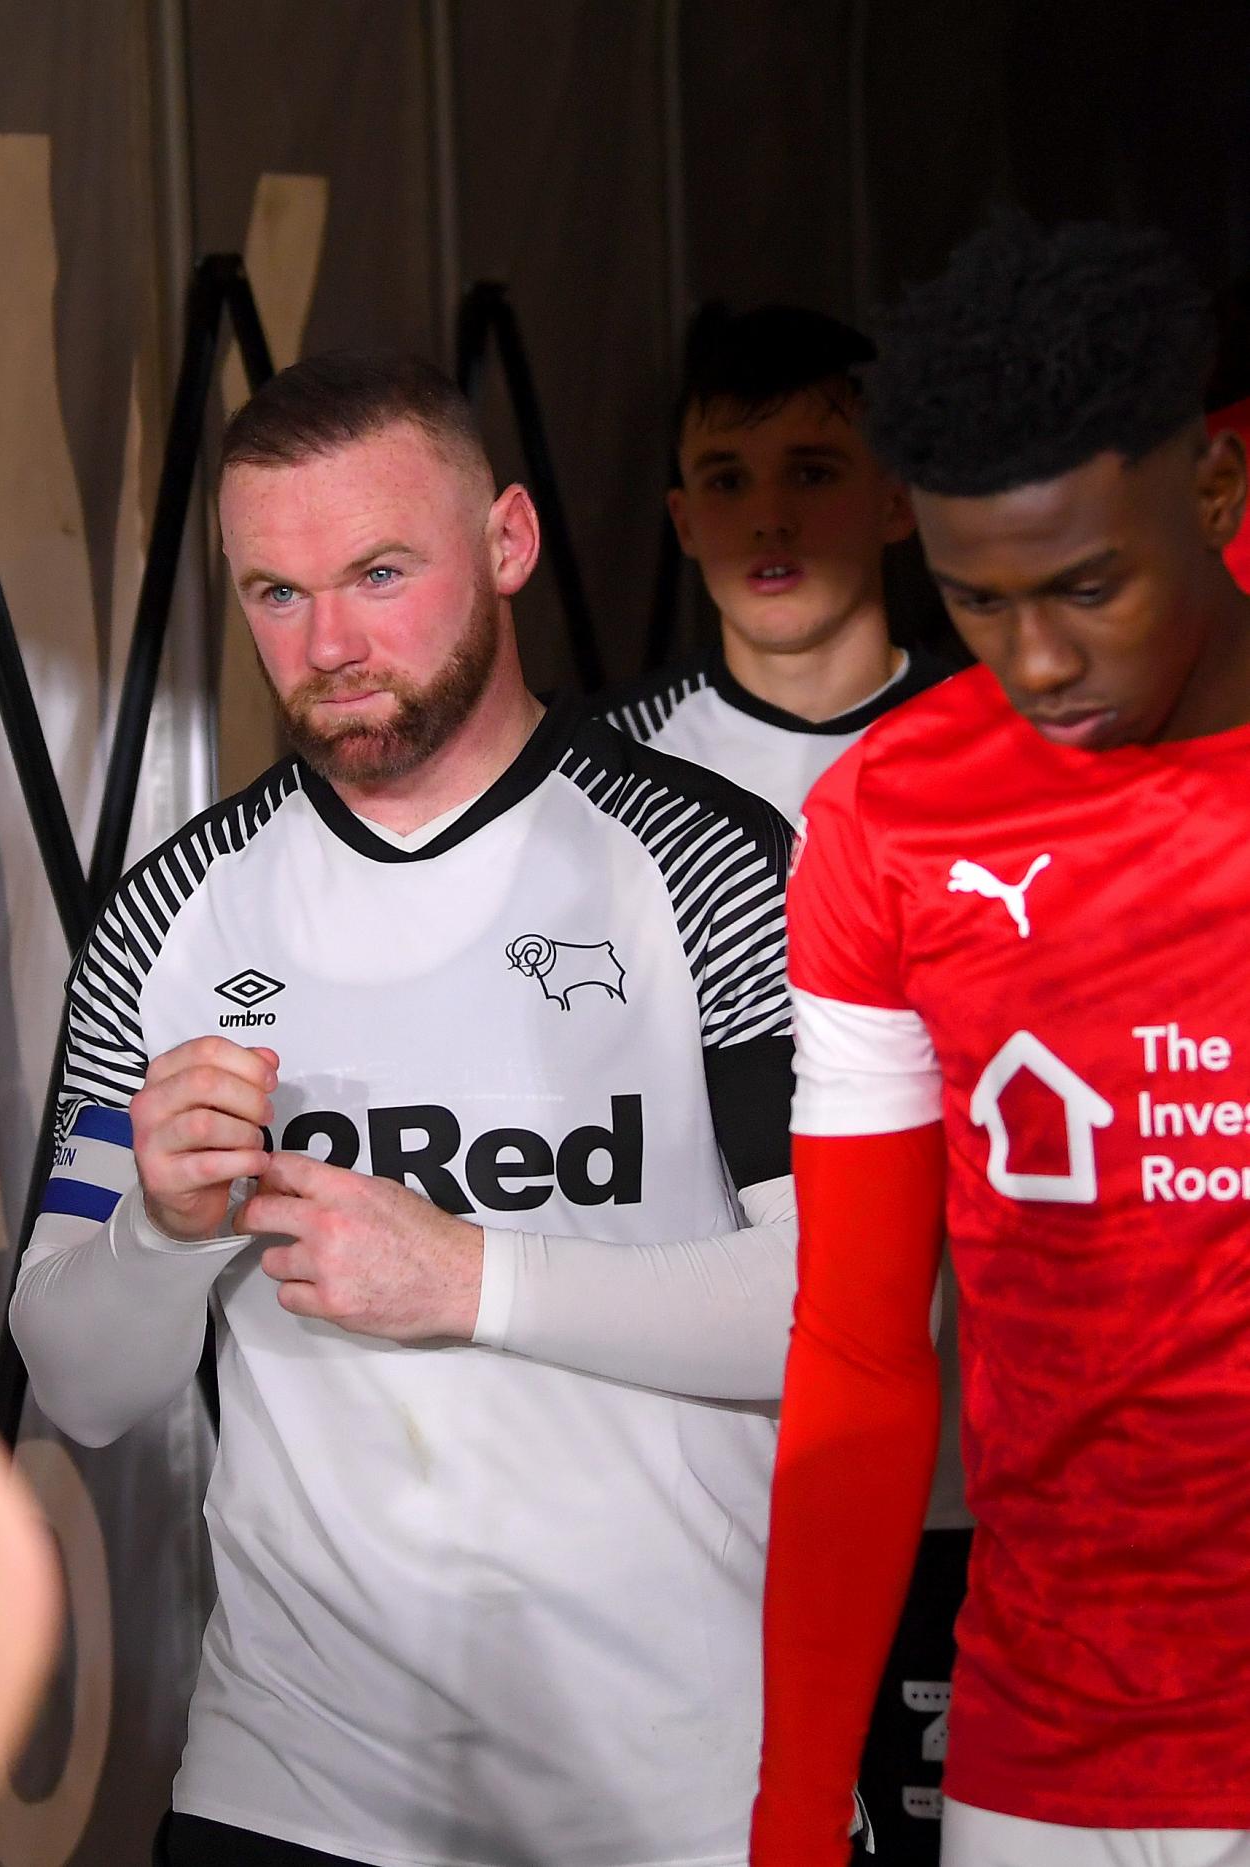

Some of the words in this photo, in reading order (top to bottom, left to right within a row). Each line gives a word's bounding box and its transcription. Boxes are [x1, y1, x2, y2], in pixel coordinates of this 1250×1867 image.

[218, 1009, 276, 1028] umbro
[1131, 1021, 1232, 1073] The
[257, 1093, 643, 1214] 2Red
[1141, 1154, 1250, 1202] Roo
